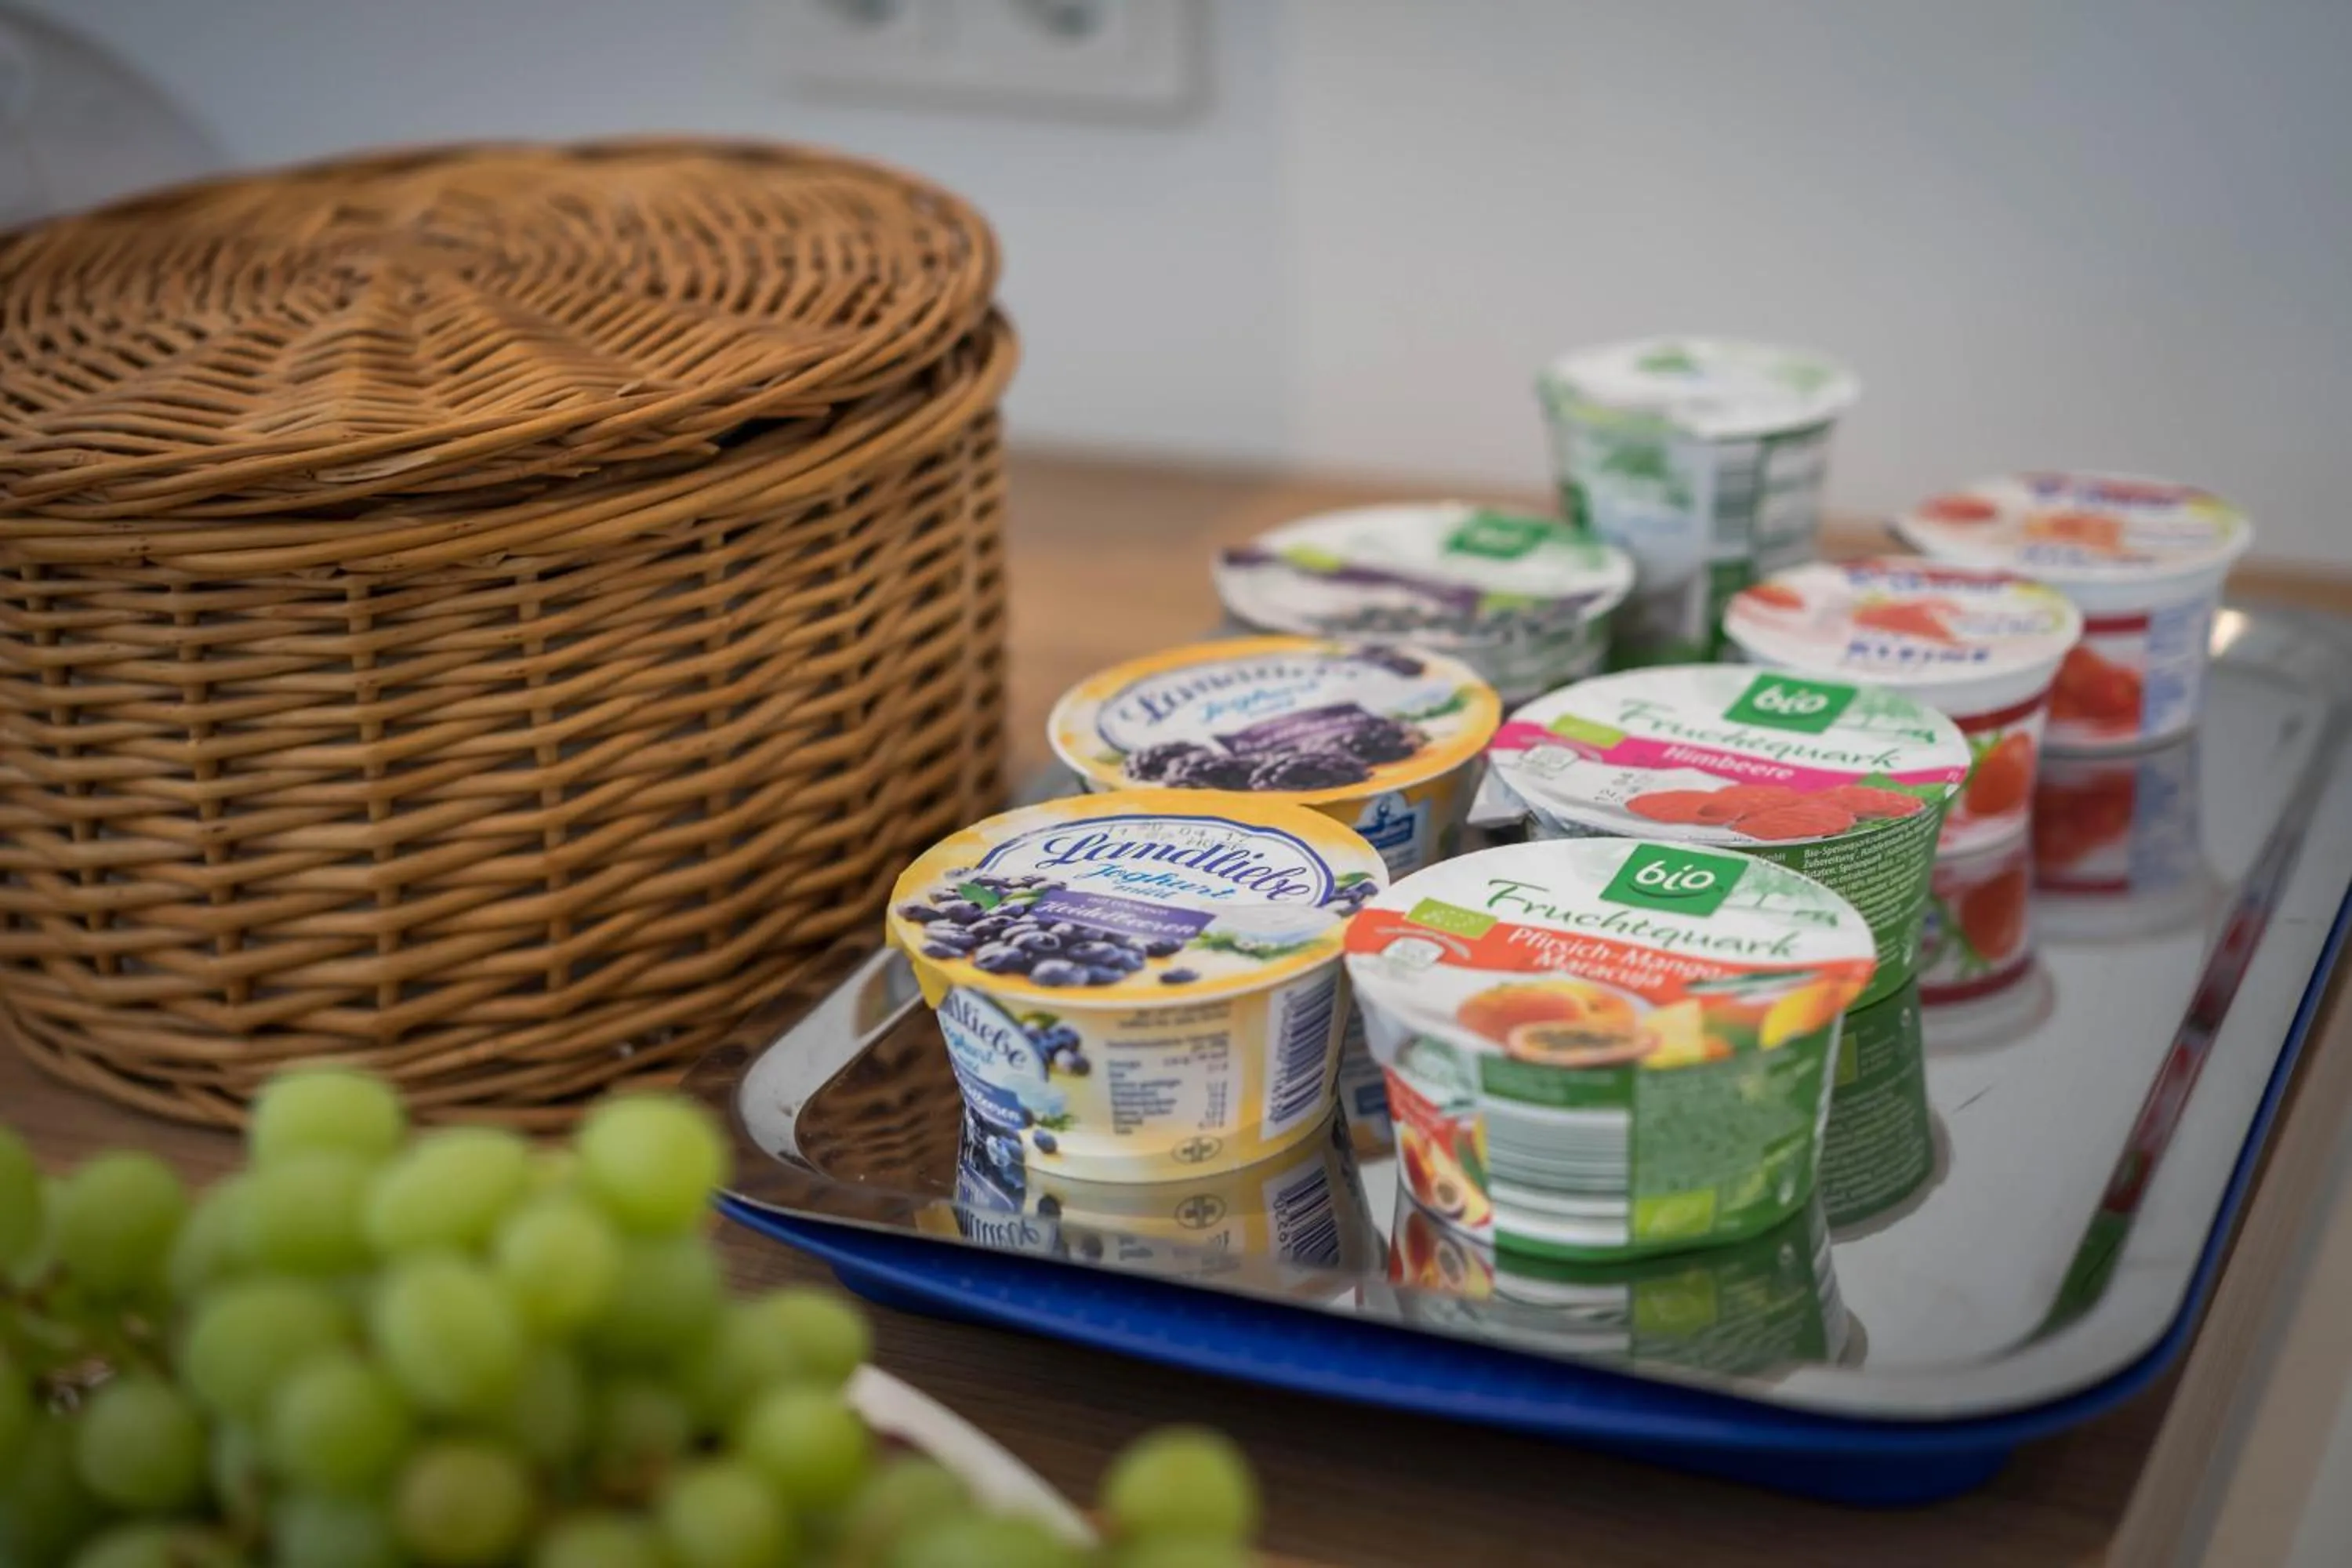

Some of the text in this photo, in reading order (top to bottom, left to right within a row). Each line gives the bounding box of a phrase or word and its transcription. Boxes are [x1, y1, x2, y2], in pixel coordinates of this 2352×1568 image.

[1753, 684, 1831, 715] bio
[1617, 700, 1904, 769] Fruchtquark
[1662, 745, 1795, 781] Himbeere
[1034, 831, 1311, 902] Landliebe
[1073, 863, 1237, 899] Joghurt
[1635, 860, 1716, 891] bio
[1486, 879, 1802, 958] Fruchtquark
[1534, 947, 1664, 989] Maracuja
